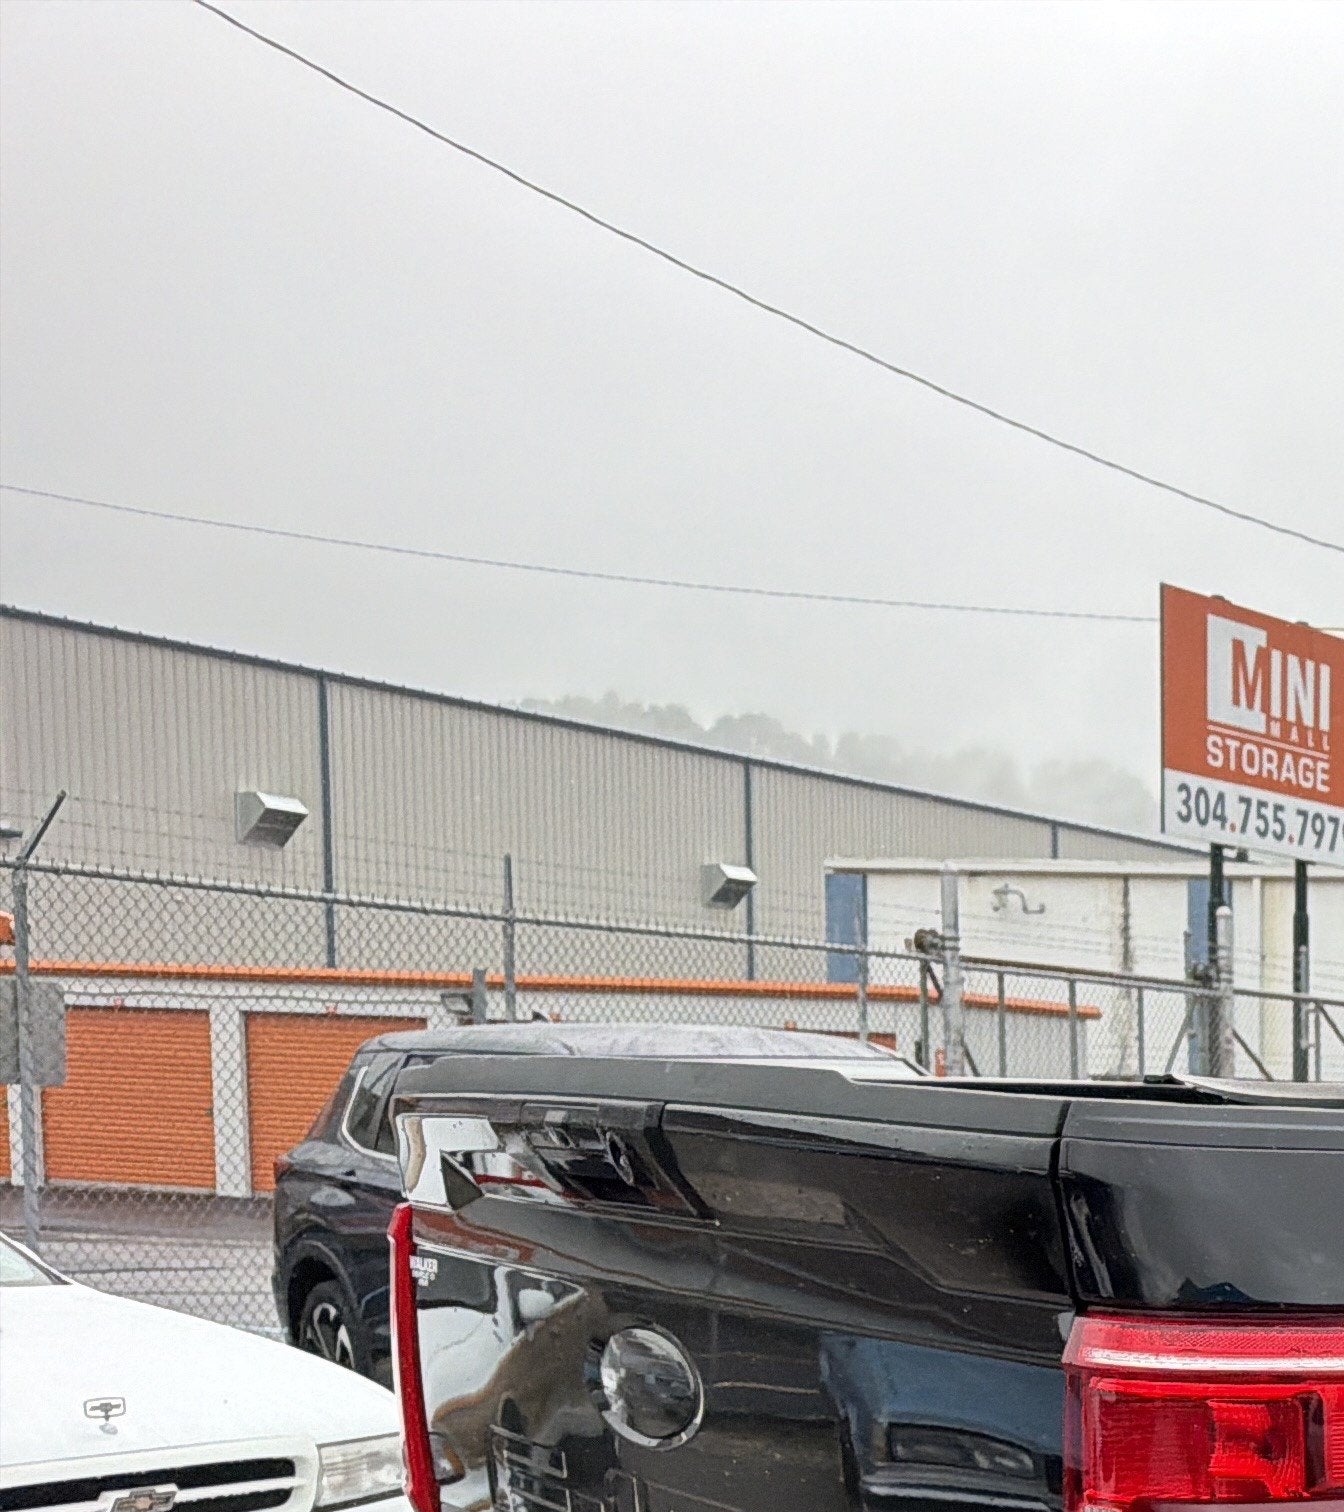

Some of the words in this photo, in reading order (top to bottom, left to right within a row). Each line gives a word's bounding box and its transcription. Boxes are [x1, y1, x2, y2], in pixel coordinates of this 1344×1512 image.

[1228, 634, 1331, 733] MINI
[1206, 734, 1331, 793] STORAGE
[1269, 719, 1331, 751] MALL
